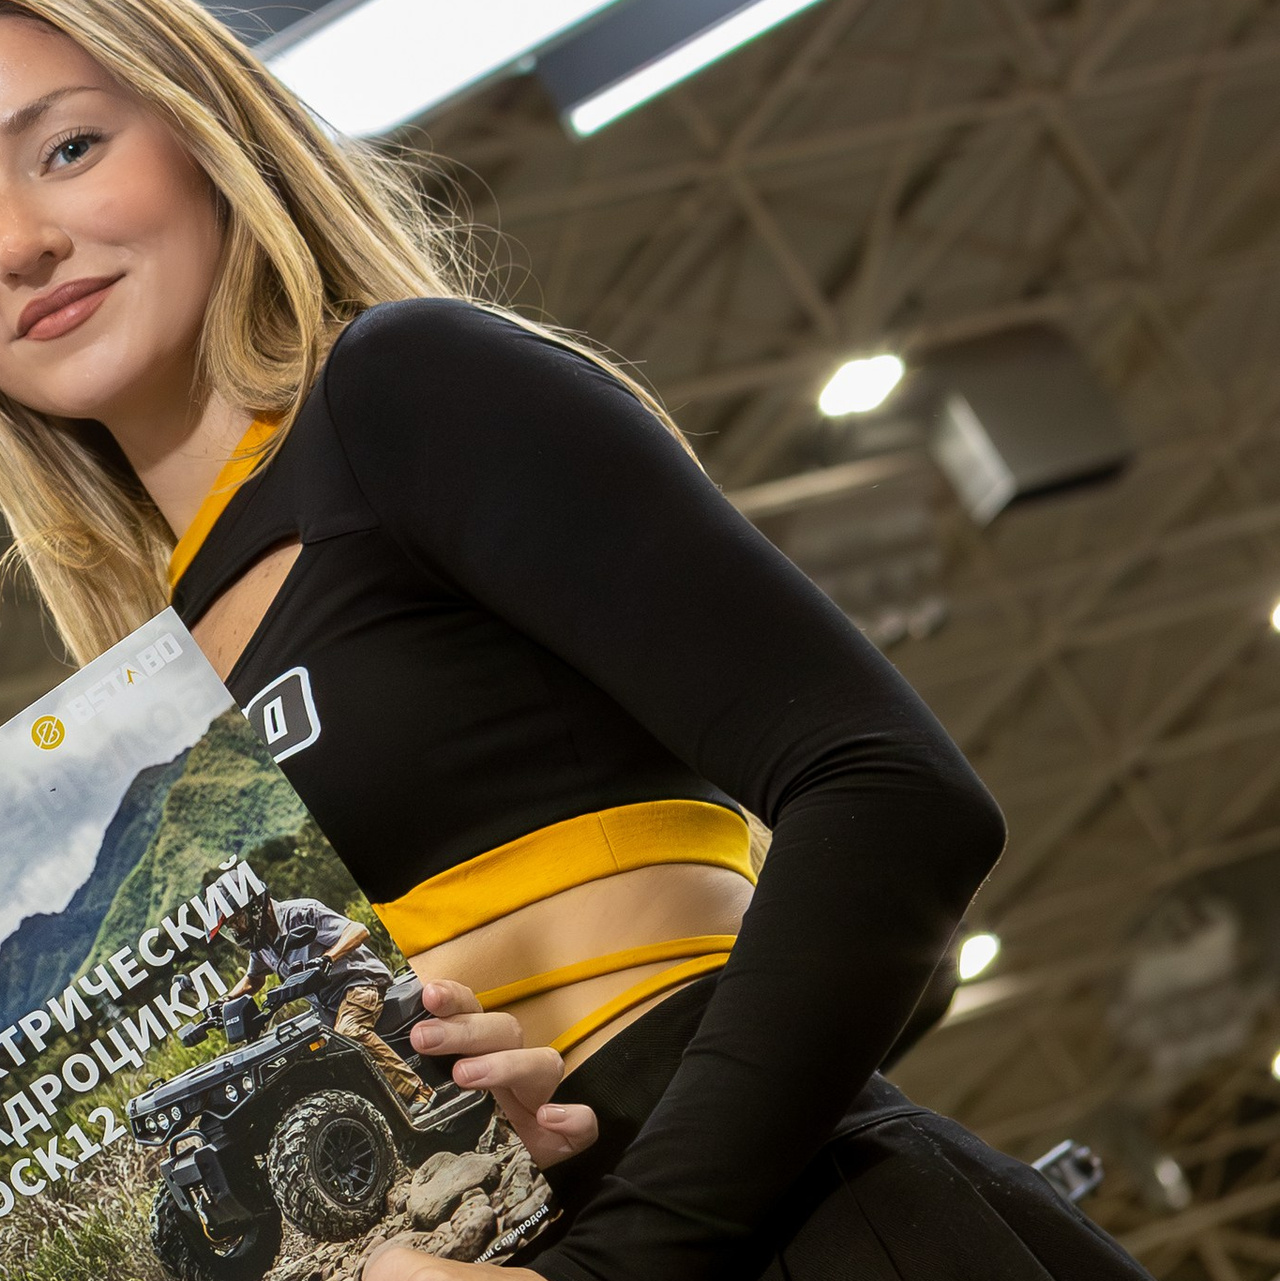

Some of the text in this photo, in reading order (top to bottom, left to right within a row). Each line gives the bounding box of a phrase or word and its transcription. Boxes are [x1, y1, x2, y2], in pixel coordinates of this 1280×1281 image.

[65, 632, 183, 721] BSTABO
[494, 1203, 549, 1252] с природой
